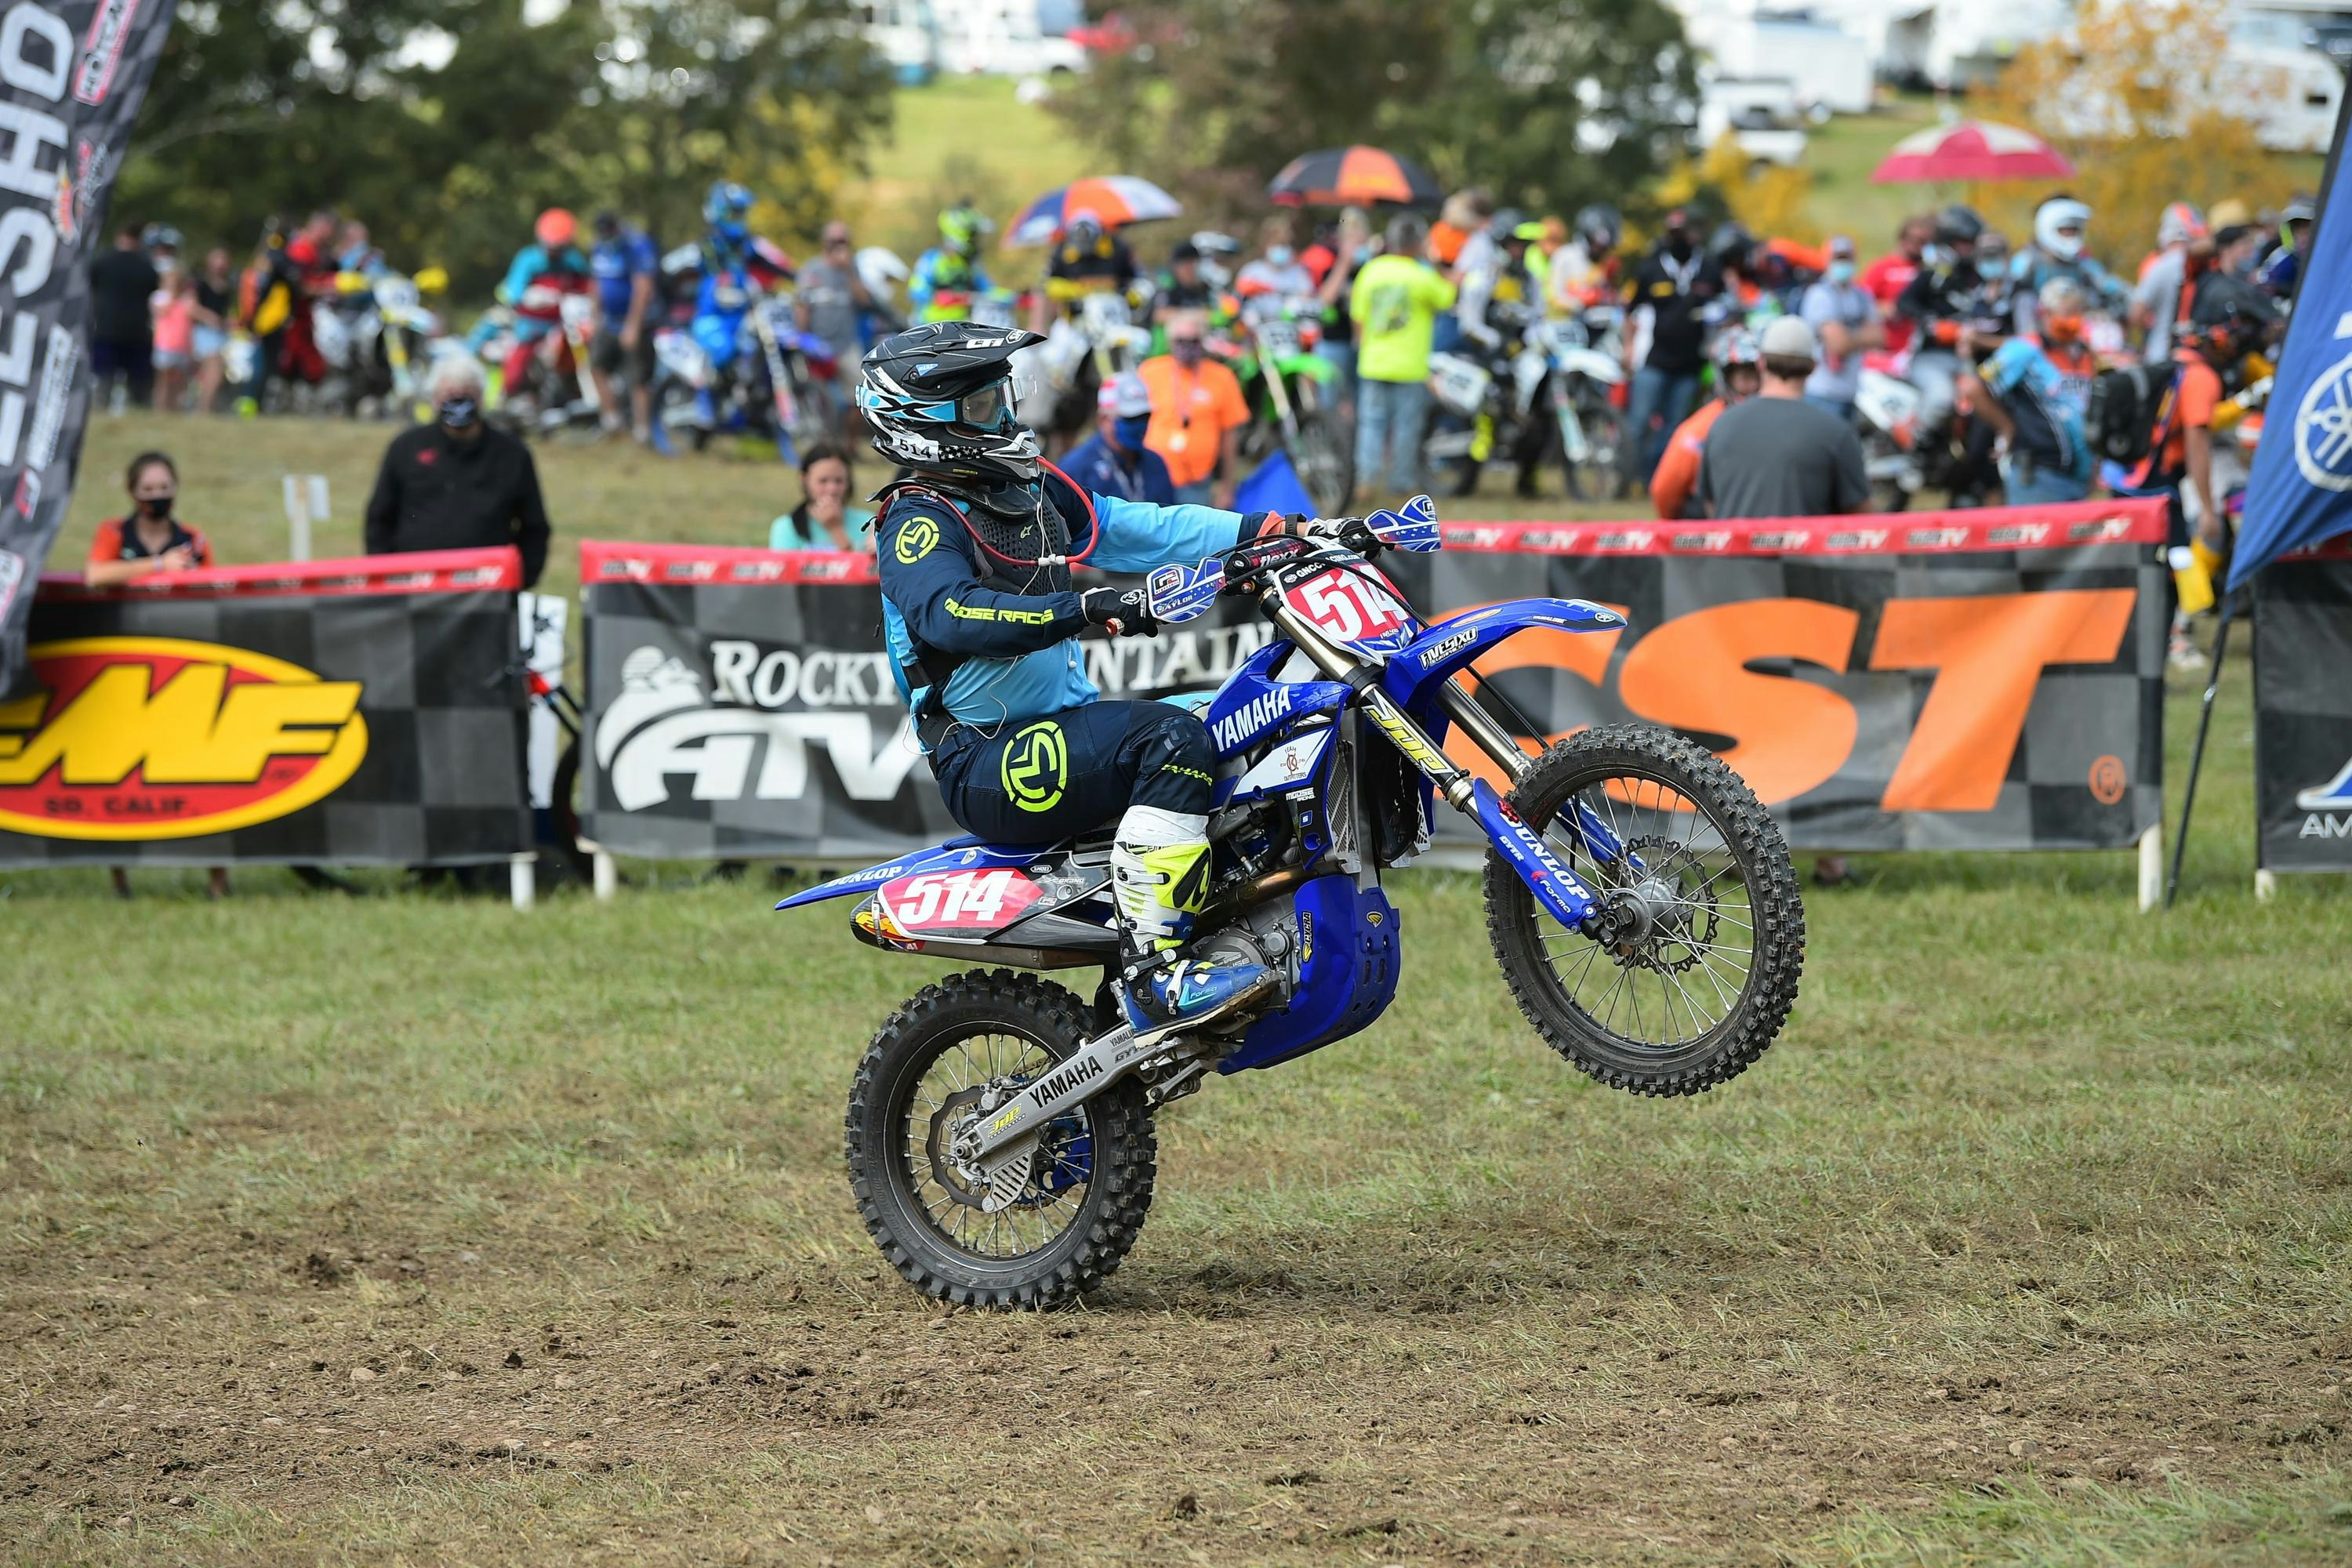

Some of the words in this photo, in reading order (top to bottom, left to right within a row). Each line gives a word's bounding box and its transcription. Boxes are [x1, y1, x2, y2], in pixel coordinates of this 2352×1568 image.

[899, 438, 932, 459] 514
[1261, 549, 1298, 567] flexx
[997, 609, 1054, 626] RAC
[1300, 564, 1409, 642] 514
[710, 640, 900, 708] ROCKY
[1082, 622, 1276, 692] NTAIN
[1211, 684, 1292, 753] YAMAHA
[612, 708, 917, 812] ATV
[1286, 787, 1315, 801] MOOSE
[1498, 835, 1525, 862] GYTR
[823, 866, 903, 888] DUNLOP
[898, 870, 1014, 925] 514
[1302, 912, 1312, 944] CYCRA
[1109, 1029, 1135, 1047] YAMALU
[1029, 1054, 1104, 1109] YAMAHA
